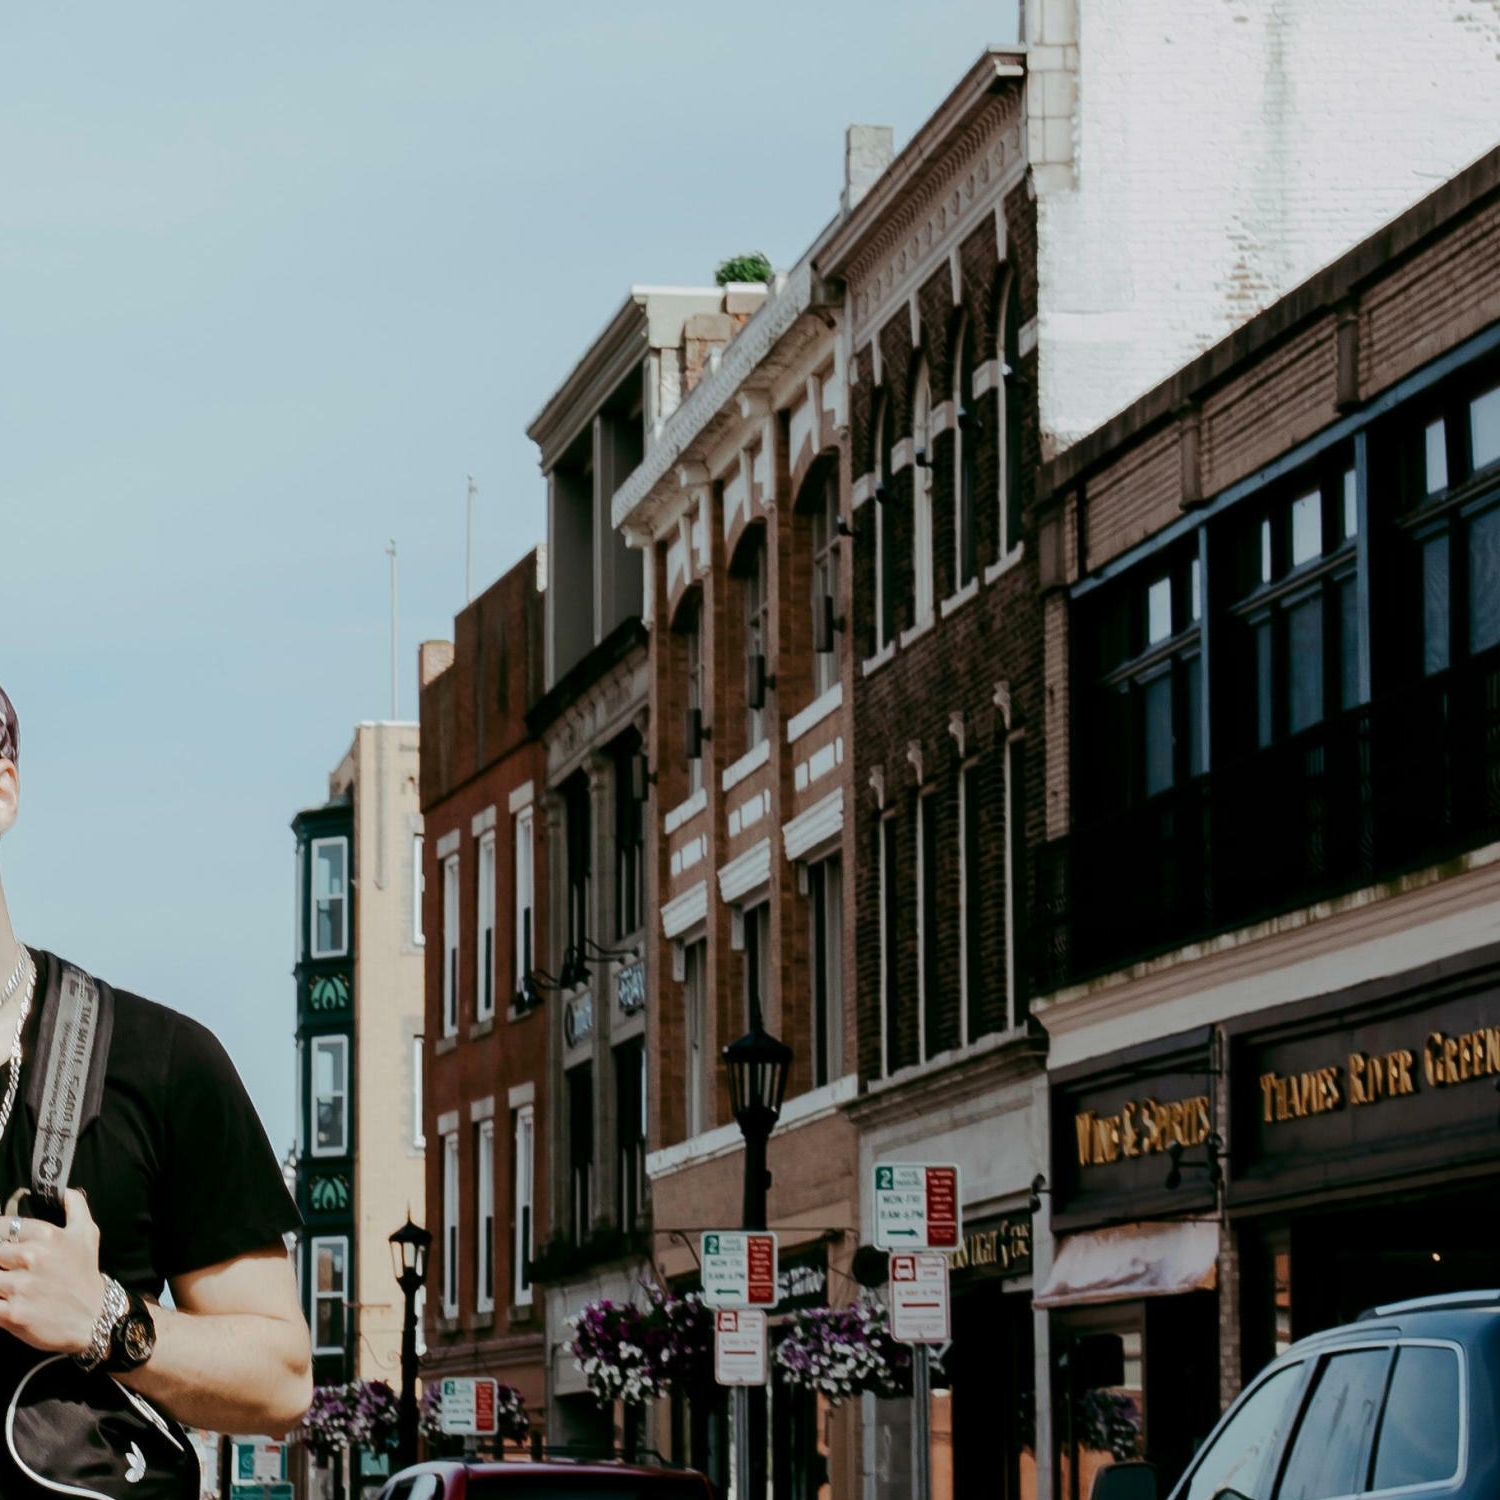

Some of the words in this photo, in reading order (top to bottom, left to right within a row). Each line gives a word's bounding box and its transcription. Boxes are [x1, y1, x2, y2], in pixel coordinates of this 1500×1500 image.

[1348, 1051, 1414, 1104] RIVER
[1122, 1101, 1140, 1157] &
[880, 1169, 891, 1188] 2
